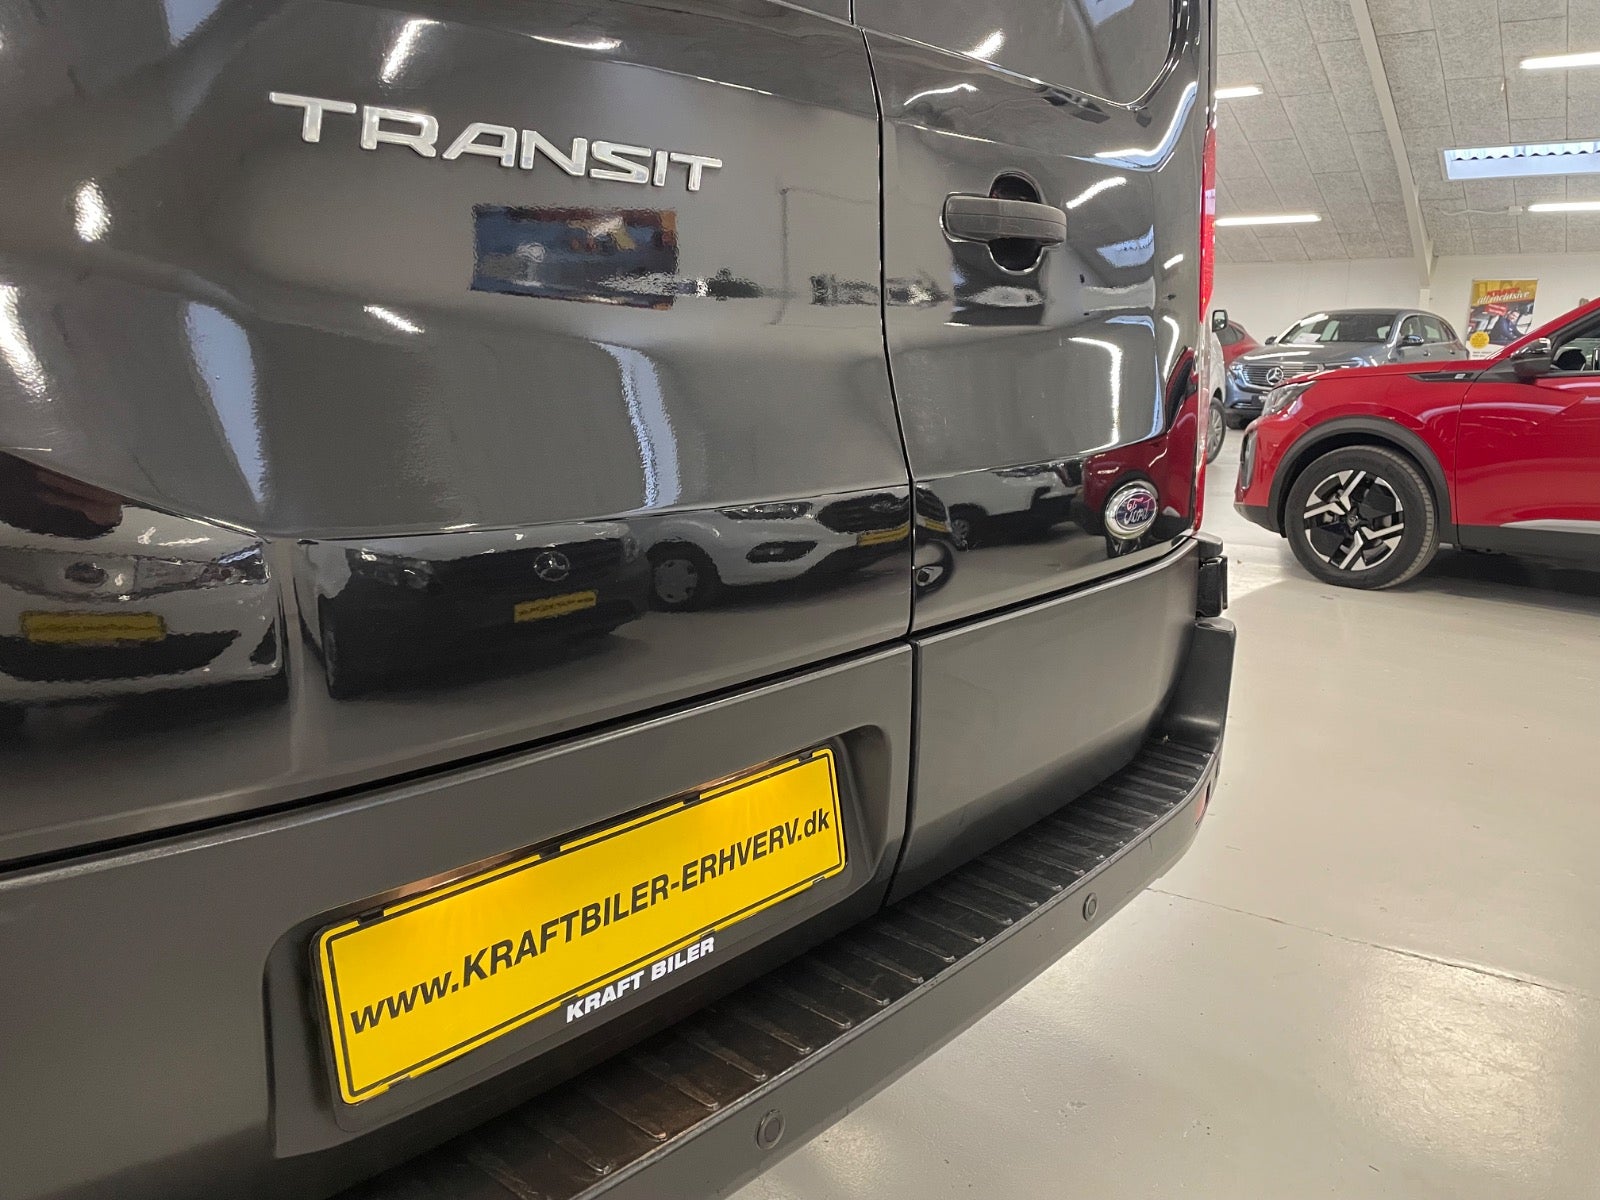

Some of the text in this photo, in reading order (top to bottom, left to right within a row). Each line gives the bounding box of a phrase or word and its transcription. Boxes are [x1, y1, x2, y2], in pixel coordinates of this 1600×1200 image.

[269, 92, 722, 190] TRANSIT
[1123, 497, 1152, 525] Ford
[350, 809, 829, 1034] www.KRAFTBILER-ERHVERV.dk
[566, 936, 715, 1024] KRAFT BILER
